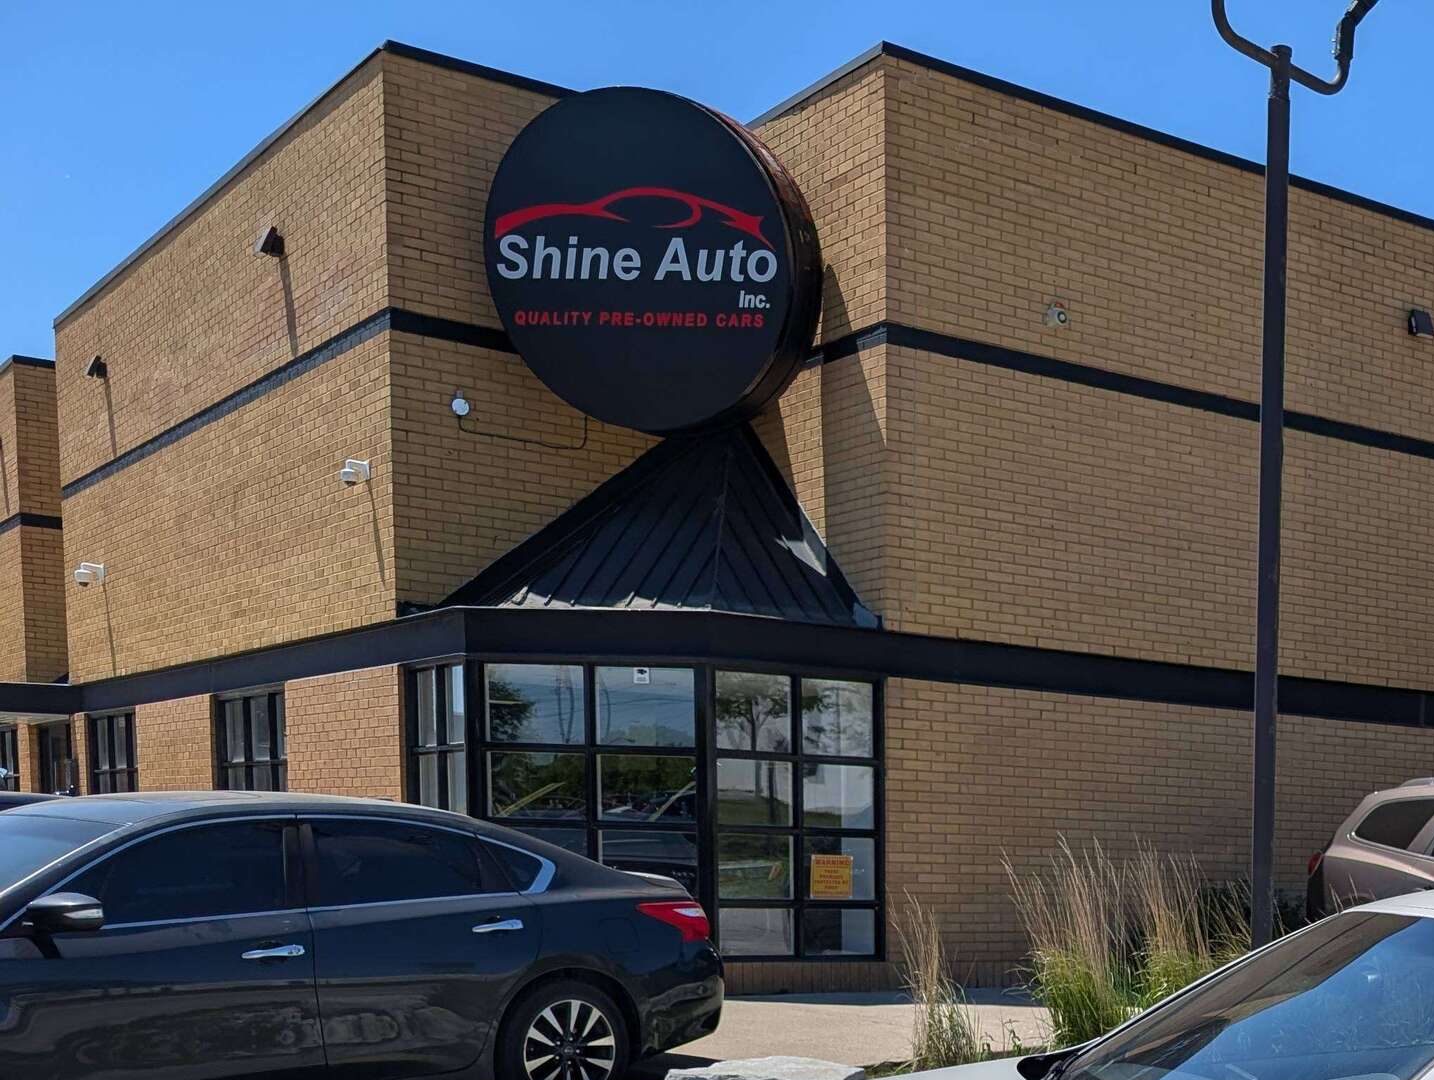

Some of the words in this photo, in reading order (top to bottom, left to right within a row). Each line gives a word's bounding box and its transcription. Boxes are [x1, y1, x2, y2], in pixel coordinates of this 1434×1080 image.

[497, 234, 641, 281] Shine
[654, 237, 778, 283] Auto
[738, 290, 771, 309] Inc.
[514, 310, 592, 327] QUALITY
[599, 311, 708, 328] PRE-OWNED
[716, 313, 765, 328] CARS
